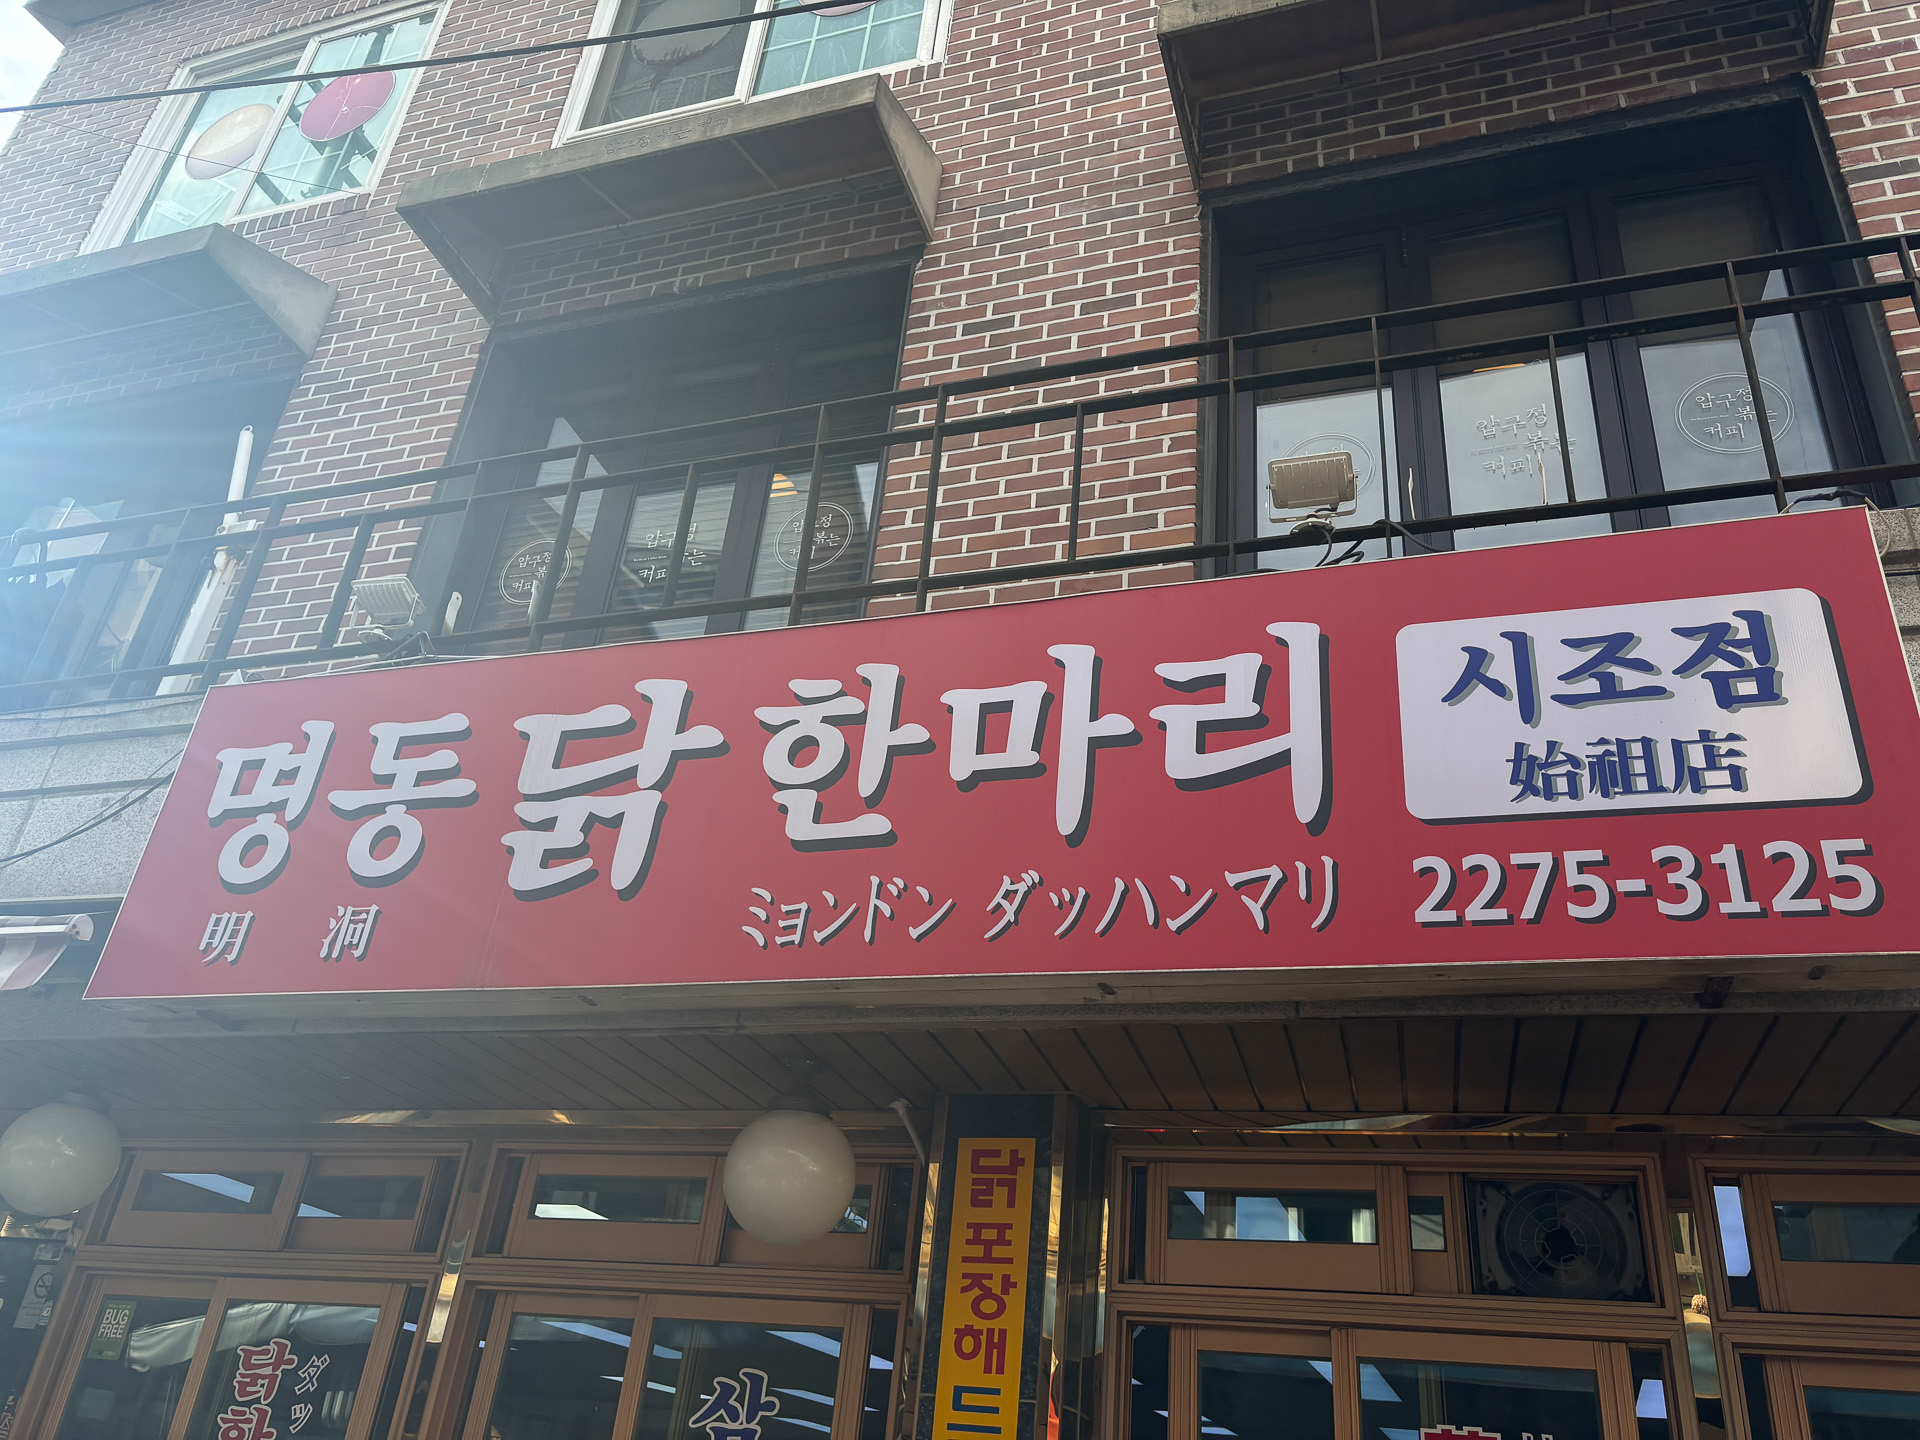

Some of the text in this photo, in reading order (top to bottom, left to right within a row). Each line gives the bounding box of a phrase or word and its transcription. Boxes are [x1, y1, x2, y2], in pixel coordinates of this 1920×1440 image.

[1695, 385, 1752, 410] 압구정
[1476, 403, 1548, 438] 압구정
[1703, 422, 1745, 440] 커피
[1483, 454, 1534, 479] 커피
[812, 531, 841, 547] 볶는
[1441, 609, 1782, 725] 시조점
[1505, 729, 1745, 802] 始祖店
[1412, 838, 1877, 923] 2275-3125
[102, 1308, 130, 1325] BUG
[97, 1324, 126, 1338] FREE
[689, 1367, 781, 1440] 삼
